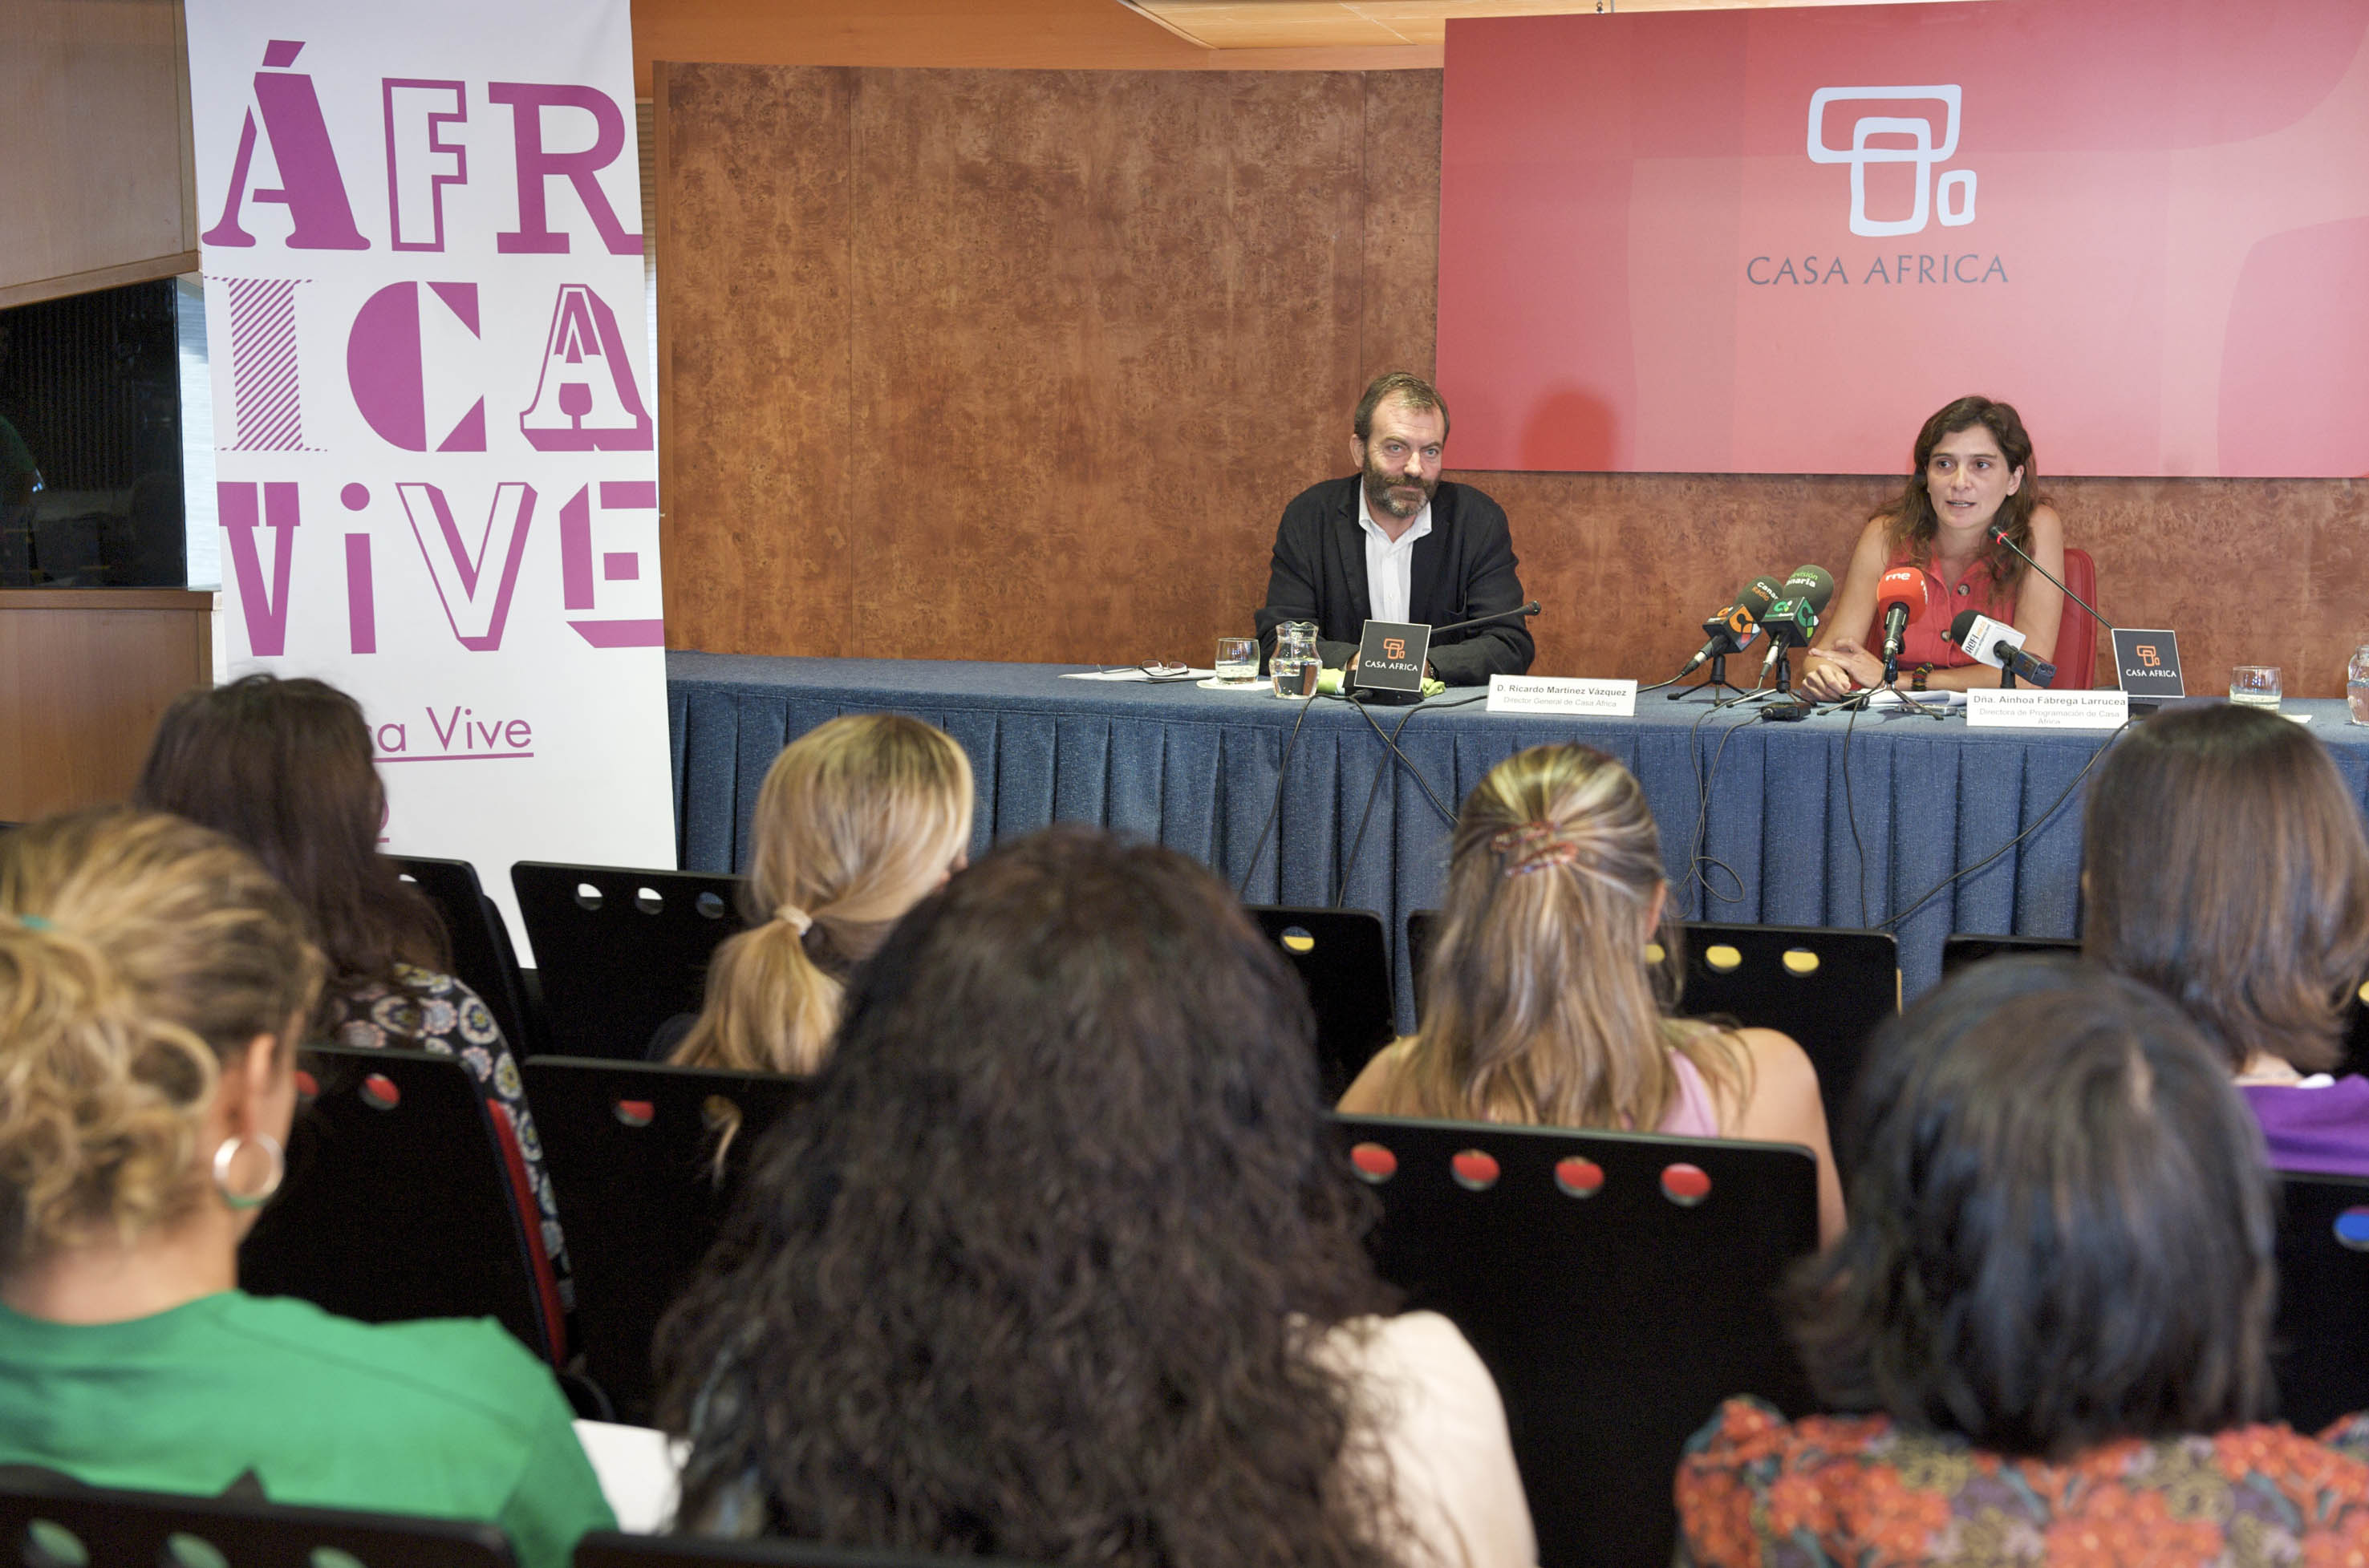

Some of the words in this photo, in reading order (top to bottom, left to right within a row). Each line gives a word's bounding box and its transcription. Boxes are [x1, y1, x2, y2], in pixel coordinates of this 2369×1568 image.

[201, 39, 644, 255] ÁFR
[1746, 256, 1849, 285] CASA
[1863, 253, 2009, 284] AFRICA
[203, 276, 655, 452] ICA
[1365, 660, 1386, 669] CASA
[1389, 662, 1418, 671] AFRICA
[2149, 670, 2177, 678] AFRICA
[1497, 684, 1506, 692] D.
[1509, 684, 1544, 693] Ricardo
[1588, 687, 1627, 697] Vázquez
[1503, 696, 1531, 704] Director
[1533, 697, 1562, 705] General
[1575, 699, 1594, 707] Casa
[1999, 695, 2034, 704] Ainhoa
[2038, 696, 2079, 706] Fábrega
[2081, 697, 2127, 706] Larrucea
[1979, 708, 2015, 716] Directora
[425, 706, 532, 752] Vive
